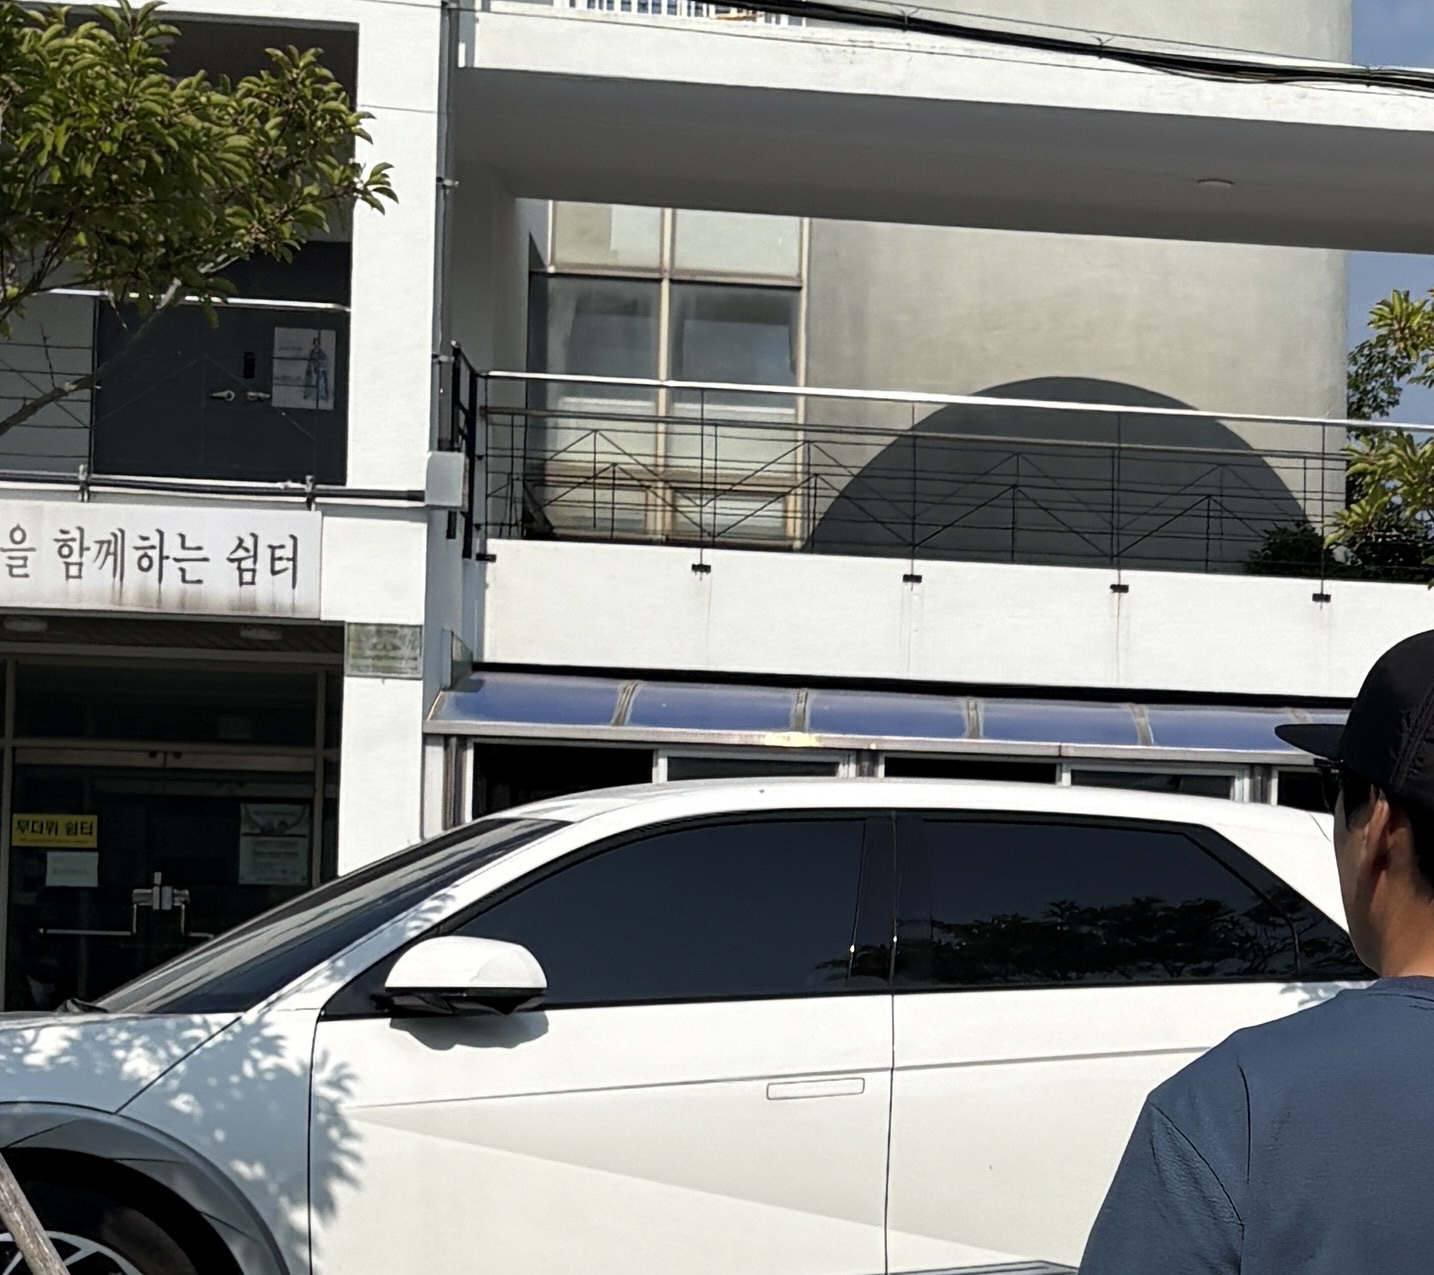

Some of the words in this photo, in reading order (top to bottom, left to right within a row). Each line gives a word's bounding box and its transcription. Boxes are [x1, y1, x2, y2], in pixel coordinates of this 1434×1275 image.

[0, 523, 37, 579] 을
[53, 525, 211, 585] 함께하는
[226, 531, 299, 590] 쉼터
